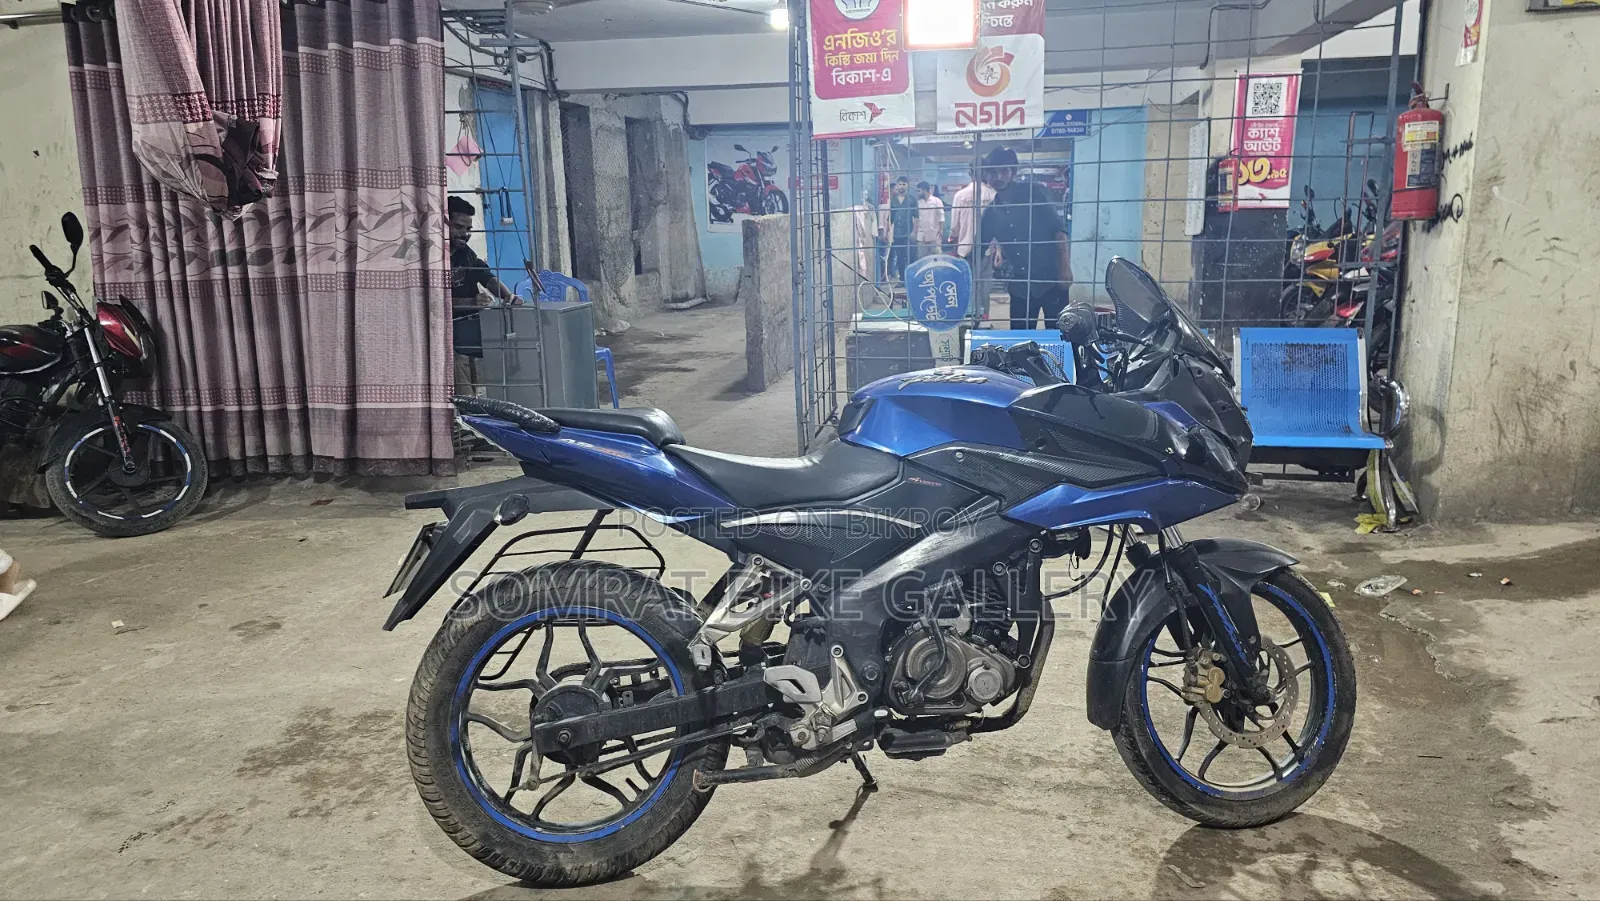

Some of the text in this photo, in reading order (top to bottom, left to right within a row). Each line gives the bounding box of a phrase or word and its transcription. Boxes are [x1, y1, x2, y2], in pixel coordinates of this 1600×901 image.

[824, 50, 899, 67] কিস্তি জমা দিন
[831, 67, 892, 87] বিকাশ-এ
[839, 108, 867, 122] বিকাশ
[954, 99, 1026, 128] নগদ
[1243, 137, 1282, 152] আউট
